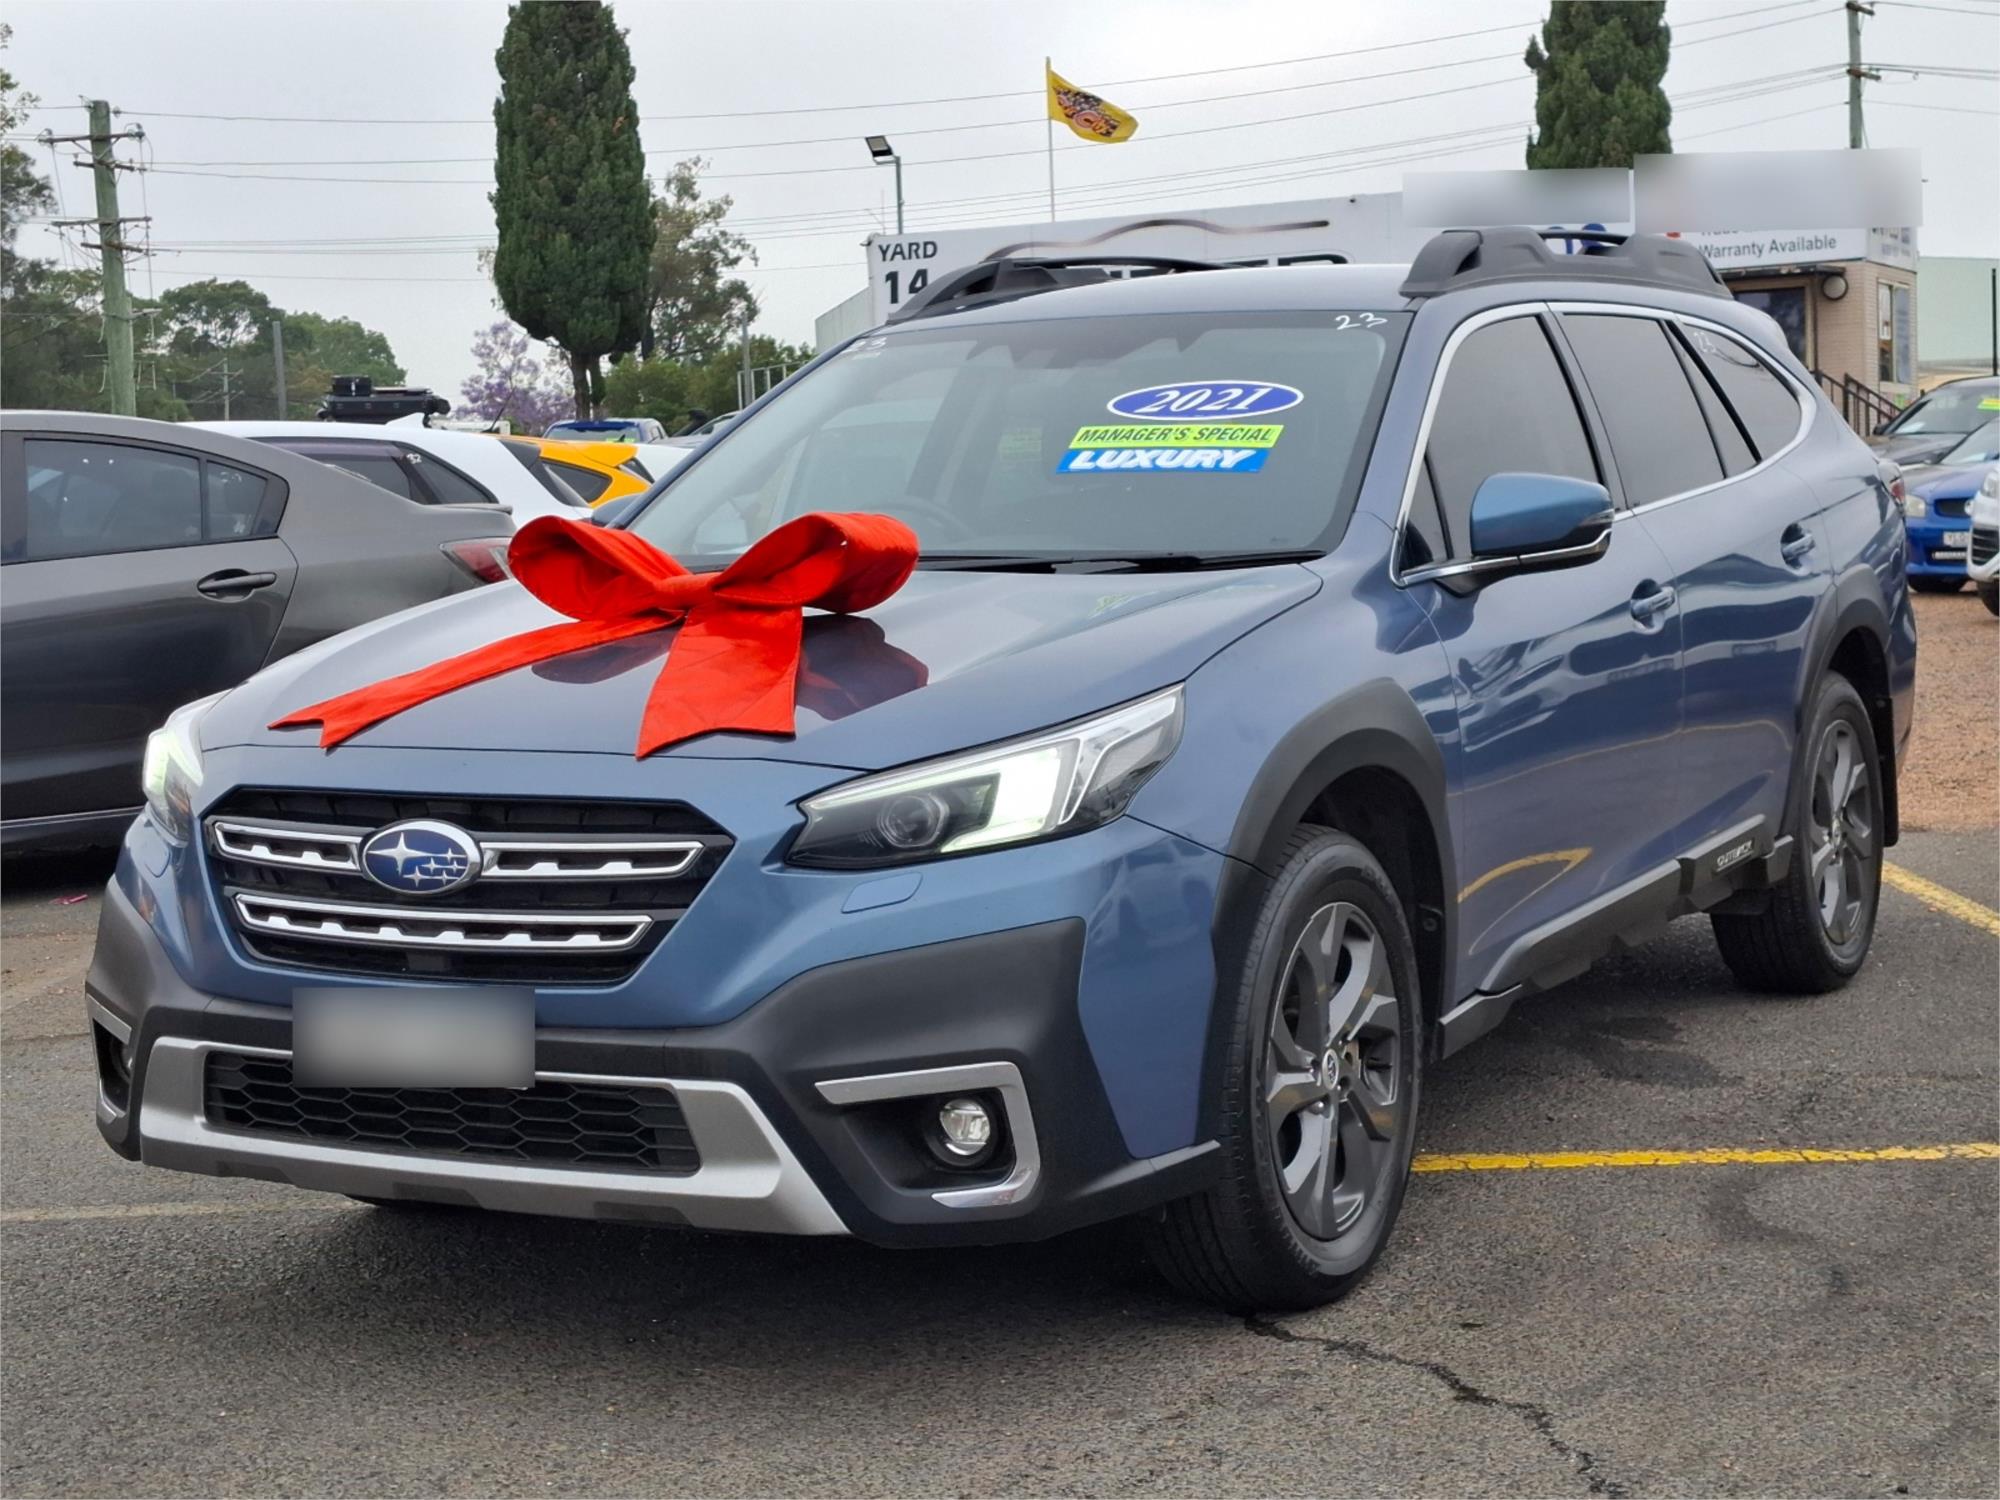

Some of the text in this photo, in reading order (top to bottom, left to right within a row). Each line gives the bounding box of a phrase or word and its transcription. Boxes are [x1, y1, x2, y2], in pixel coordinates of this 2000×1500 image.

[878, 241, 938, 262] YARD
[1700, 235, 1837, 259] Warranty Available
[885, 269, 928, 304] 14
[1335, 312, 1388, 330] 23
[1133, 387, 1275, 414] 2021
[1077, 426, 1273, 442] MANAGER'S SPECIAL
[1069, 449, 1256, 469] LUXURY
